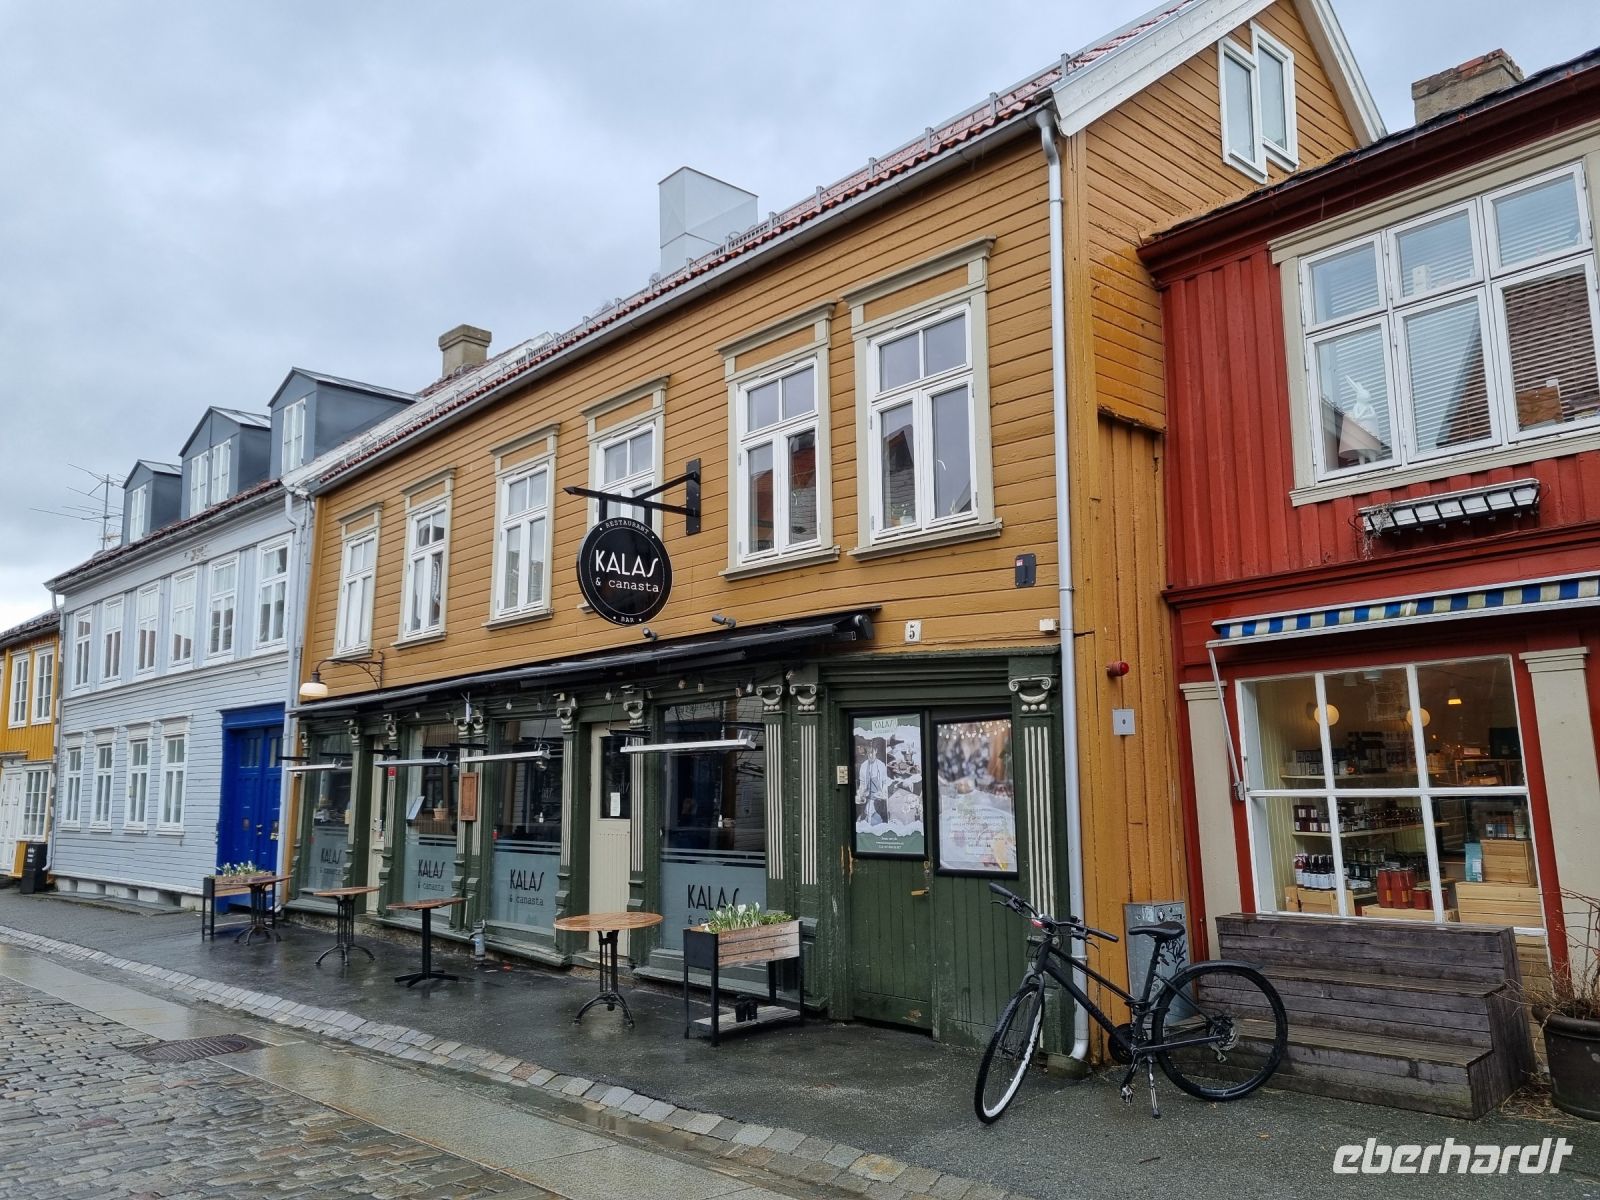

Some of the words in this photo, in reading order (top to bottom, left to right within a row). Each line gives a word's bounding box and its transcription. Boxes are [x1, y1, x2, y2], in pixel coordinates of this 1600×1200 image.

[605, 519, 650, 535] RESTAURANT
[595, 549, 659, 578] KALAS
[595, 577, 601, 586] &
[608, 579, 660, 593] canasta
[909, 624, 916, 639] 5
[320, 847, 342, 865] KALAS
[417, 859, 446, 879] KALAS
[509, 868, 545, 892] KALAS
[515, 895, 545, 906] canasta
[687, 884, 740, 911] KALAS
